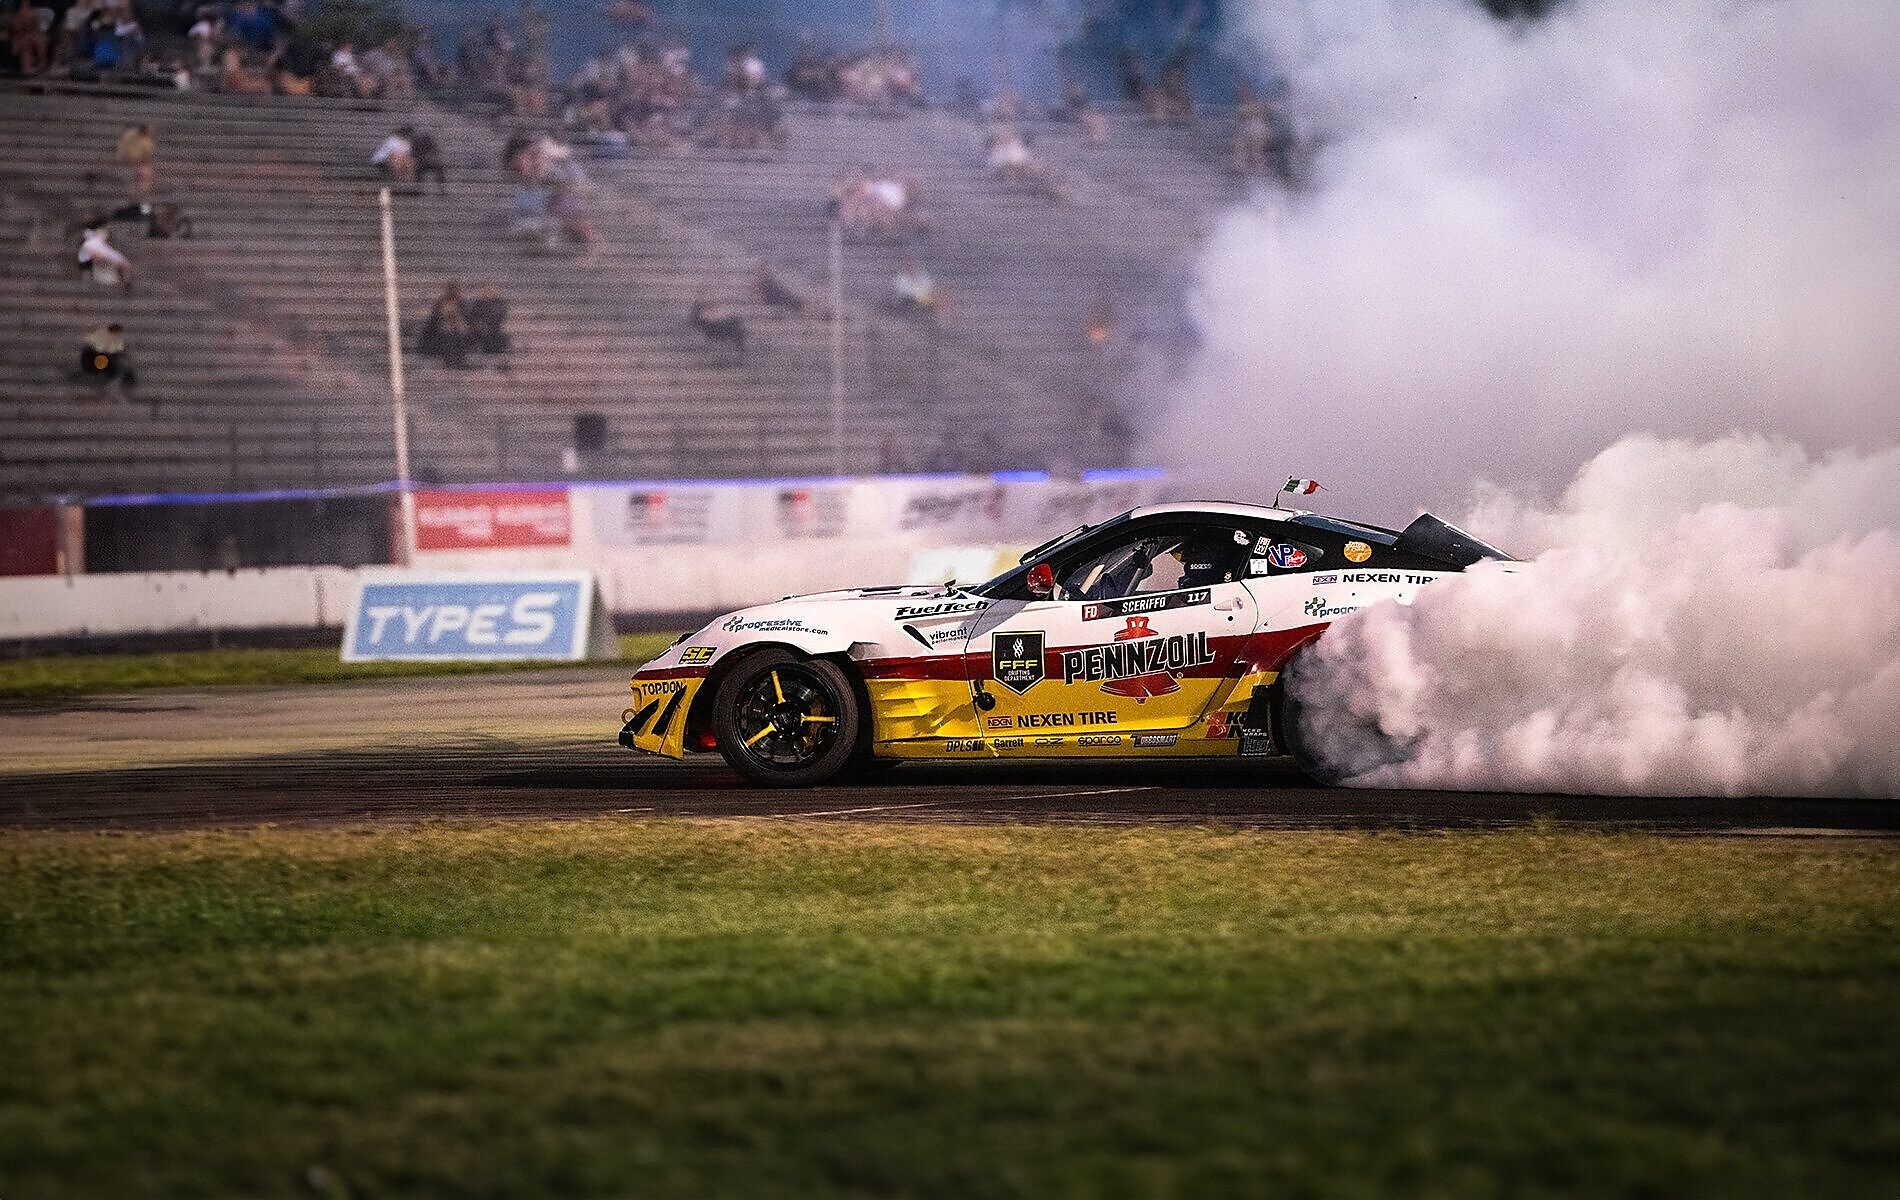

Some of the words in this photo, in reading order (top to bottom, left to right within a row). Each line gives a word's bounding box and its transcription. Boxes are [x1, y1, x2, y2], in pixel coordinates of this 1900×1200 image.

[1268, 544, 1294, 567] VP
[1343, 574, 1400, 583] NEXEN
[1406, 574, 1438, 585] TIR
[895, 600, 989, 617] FuelTech
[1084, 605, 1098, 619] FD
[1122, 597, 1166, 614] SCERIFFO
[1187, 591, 1209, 604] 117
[735, 618, 803, 633] progressive
[759, 625, 829, 636] medicalstore.com
[929, 627, 968, 641] vibrant
[1000, 660, 1038, 670] FFF
[1060, 631, 1216, 686] PENNZOIL
[1008, 669, 1031, 677] DRIFTING
[641, 681, 683, 696] TOPDON
[1017, 713, 1074, 728] NEXEN
[1078, 711, 1118, 725] TIRE
[994, 738, 1025, 749] Garrett
[1078, 735, 1122, 746] sparco
